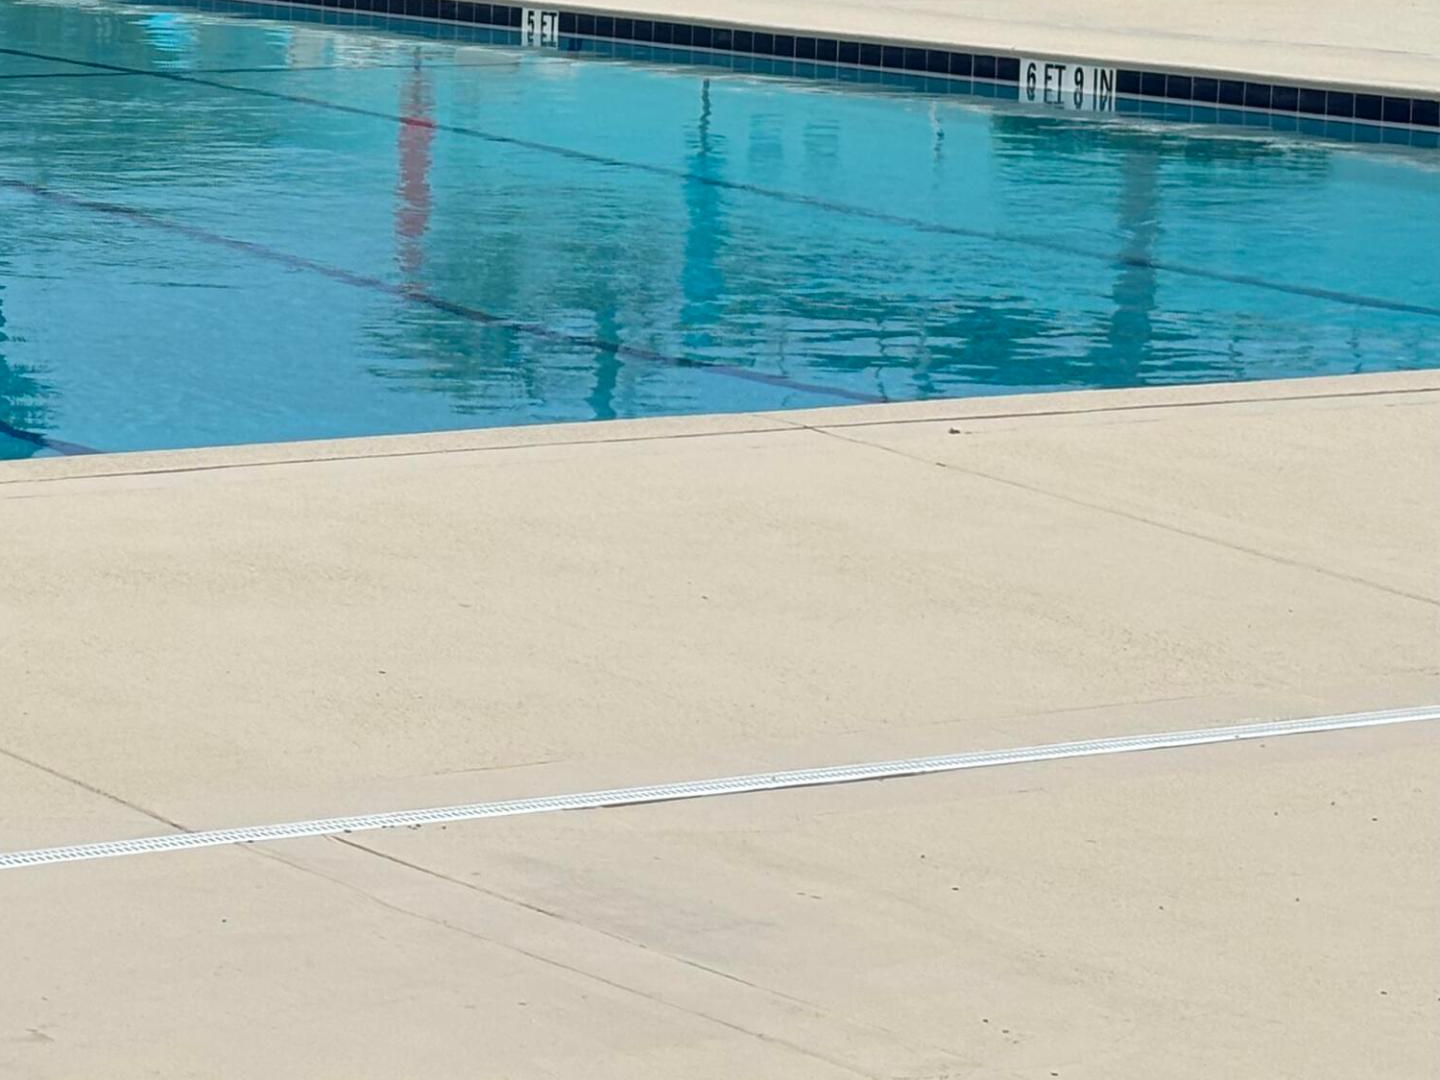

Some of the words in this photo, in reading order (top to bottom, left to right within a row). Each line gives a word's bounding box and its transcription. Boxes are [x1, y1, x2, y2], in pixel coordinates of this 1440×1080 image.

[540, 11, 558, 33] FT
[1026, 62, 1037, 88] 6
[1044, 63, 1066, 90] FT
[1074, 66, 1084, 91] 9
[1093, 68, 1113, 94] IN
